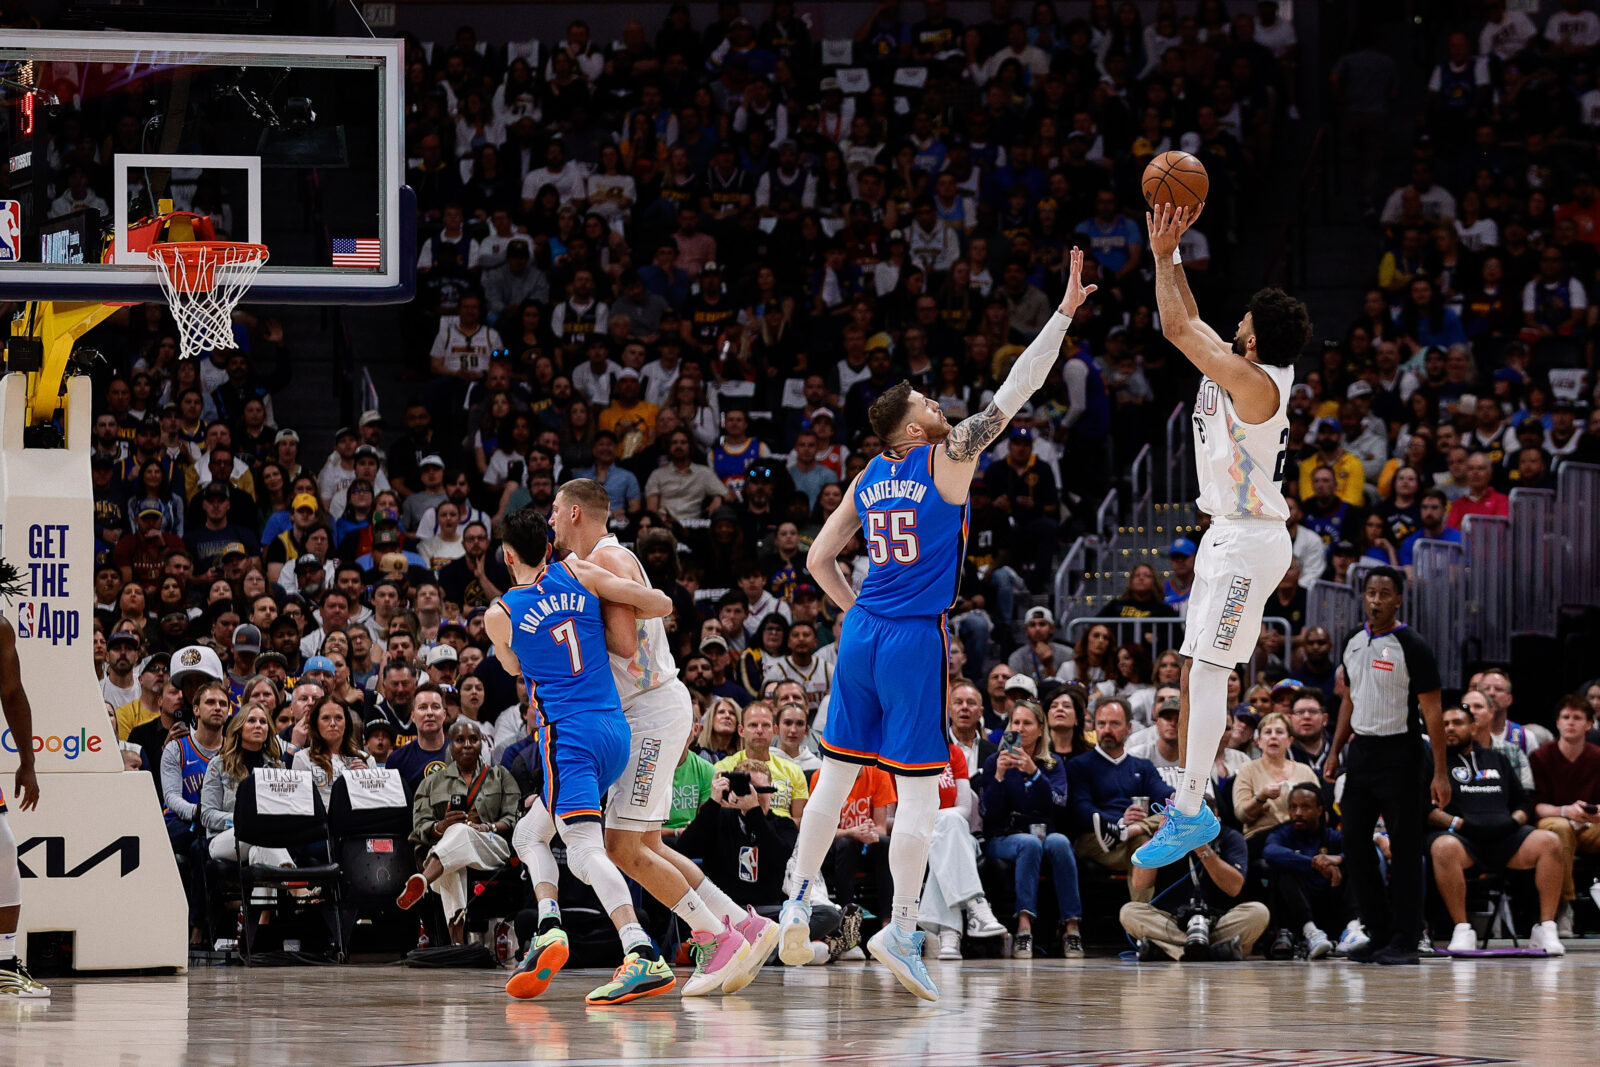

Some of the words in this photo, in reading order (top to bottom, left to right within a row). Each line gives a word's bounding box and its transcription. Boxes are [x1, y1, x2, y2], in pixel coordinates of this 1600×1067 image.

[28, 523, 70, 559] GET
[867, 508, 920, 566] 55
[27, 562, 70, 598] THE
[38, 602, 80, 646] App
[519, 592, 586, 635] HOLMGREN
[1212, 575, 1252, 652] DENVER
[550, 617, 584, 676] 7
[1, 727, 102, 760] Google
[630, 737, 662, 807] DENVER
[672, 784, 700, 798] NCE
[671, 797, 699, 811] PIRE
